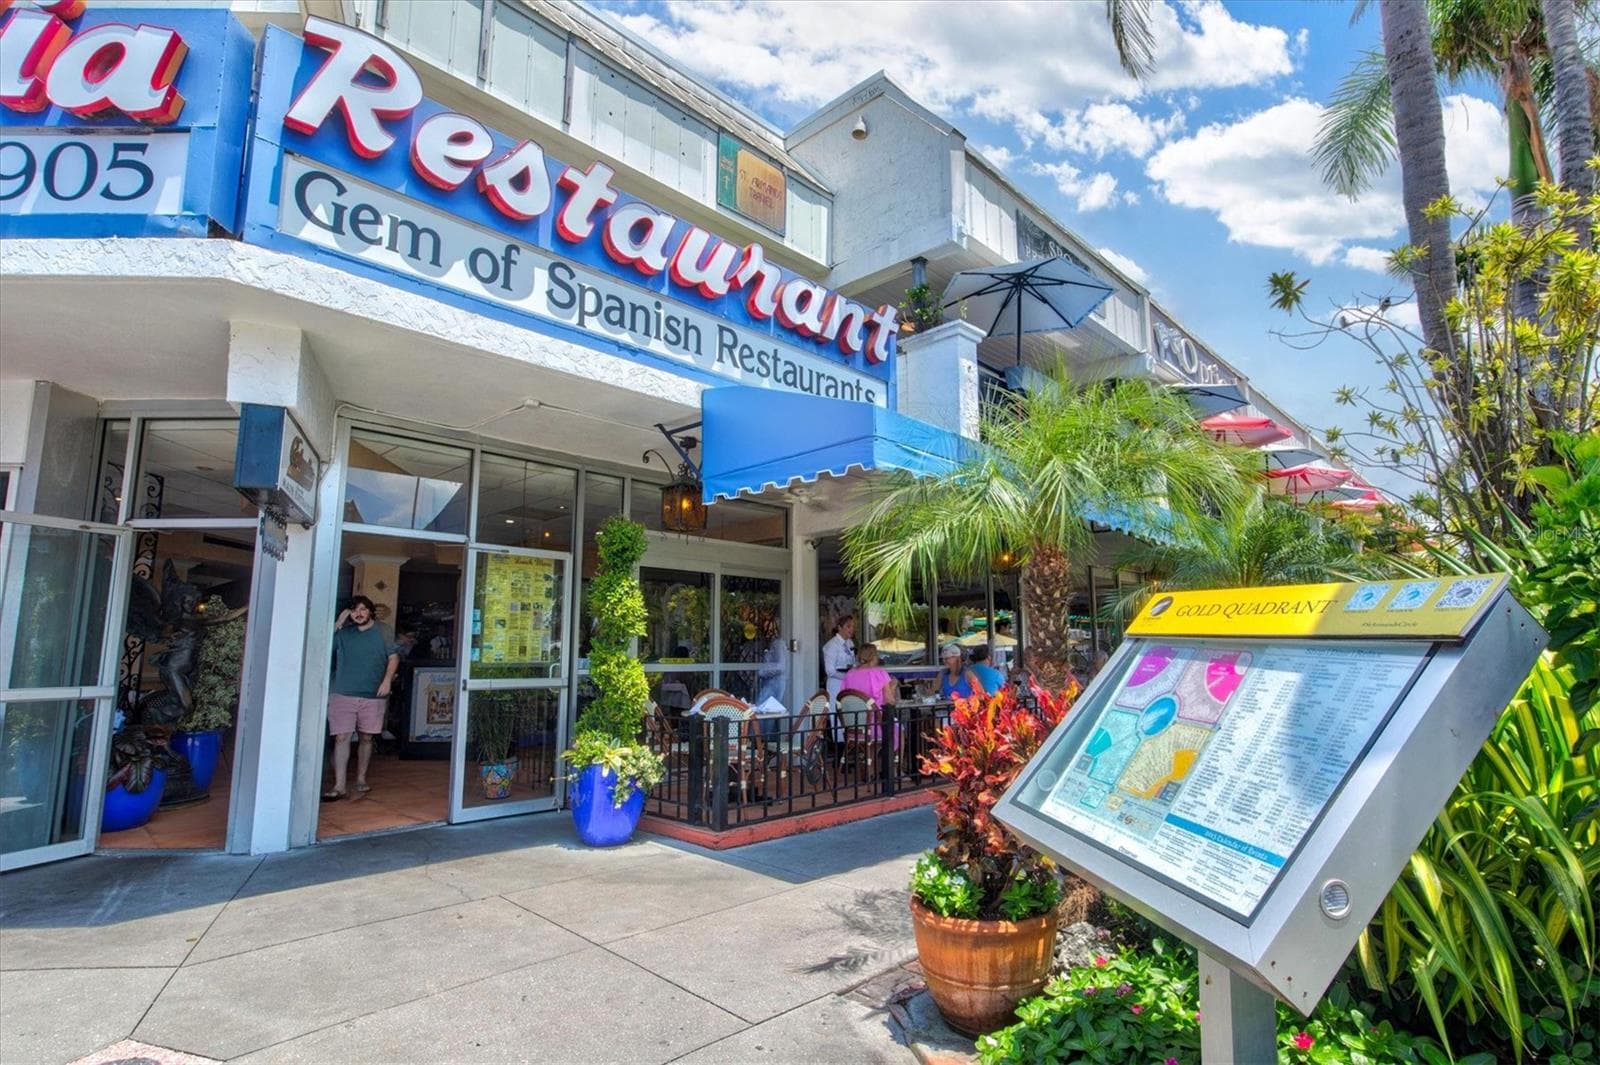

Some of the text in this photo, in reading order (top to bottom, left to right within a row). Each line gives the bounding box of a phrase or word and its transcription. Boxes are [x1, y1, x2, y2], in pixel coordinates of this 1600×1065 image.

[283, 14, 899, 364] Restaurant
[294, 170, 877, 404] Gem of Spanish Restaurants
[1176, 600, 1337, 619] GOLD QUADRANT
